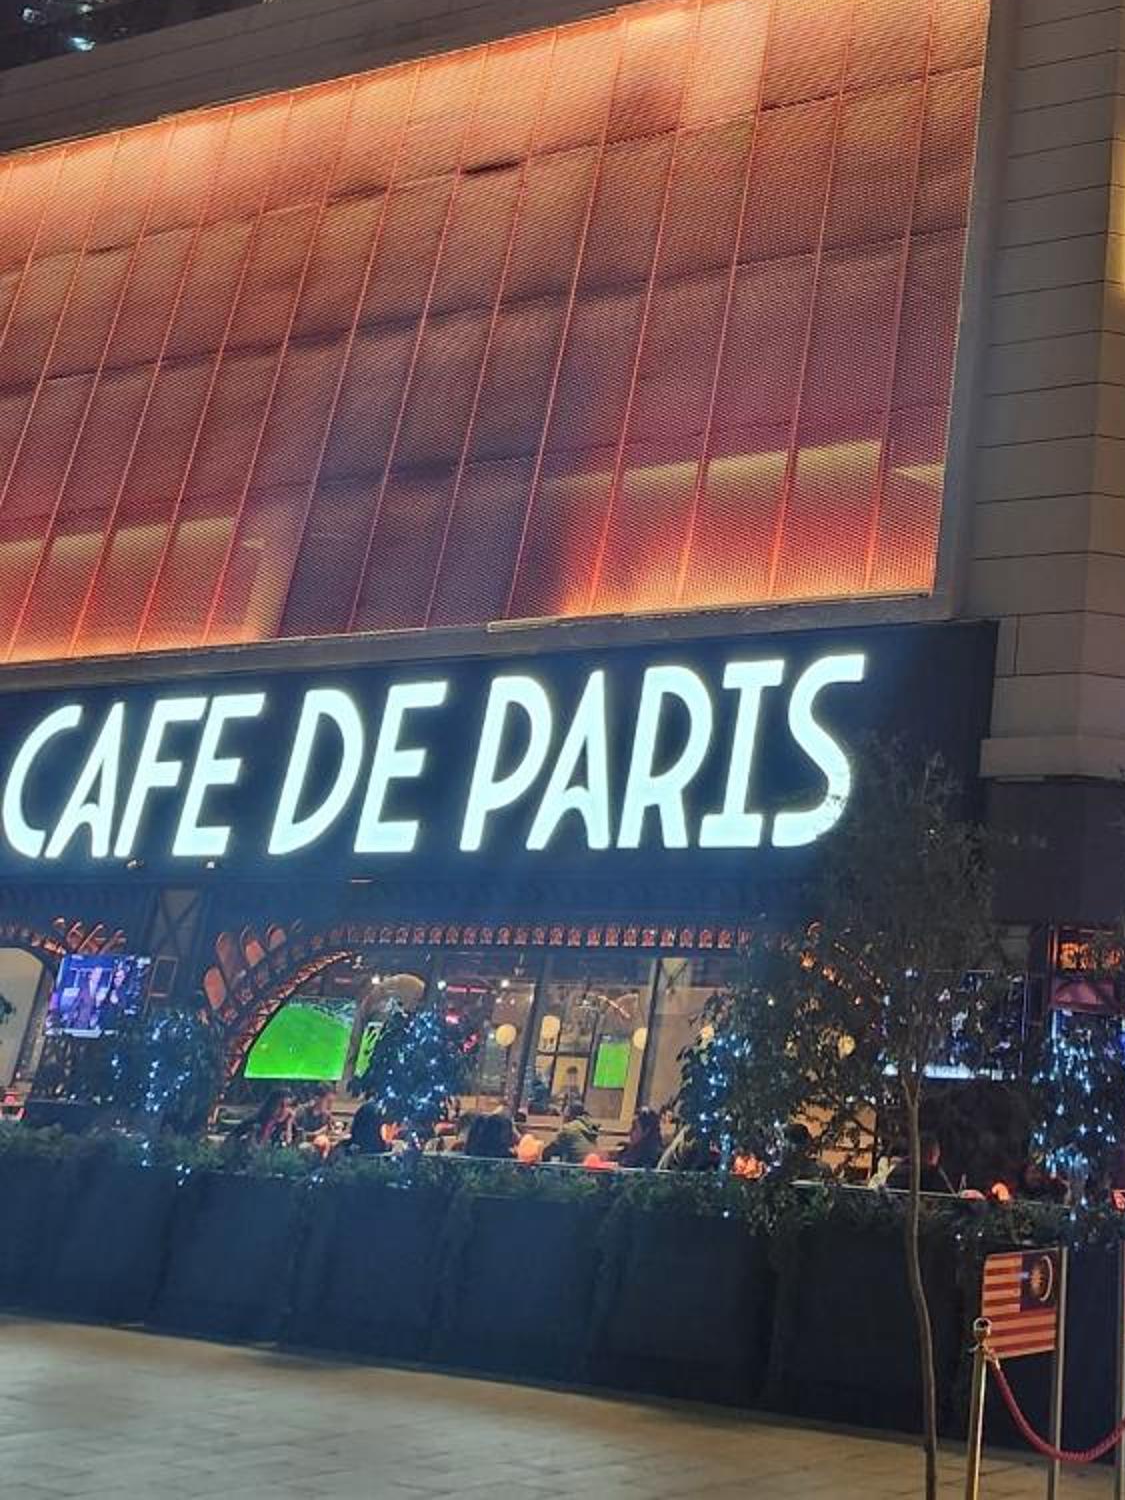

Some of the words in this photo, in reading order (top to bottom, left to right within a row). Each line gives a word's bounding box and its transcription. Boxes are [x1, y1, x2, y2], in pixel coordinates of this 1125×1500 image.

[1, 691, 266, 859] CAFE
[268, 680, 448, 855] DE
[459, 653, 866, 852] PARIS
